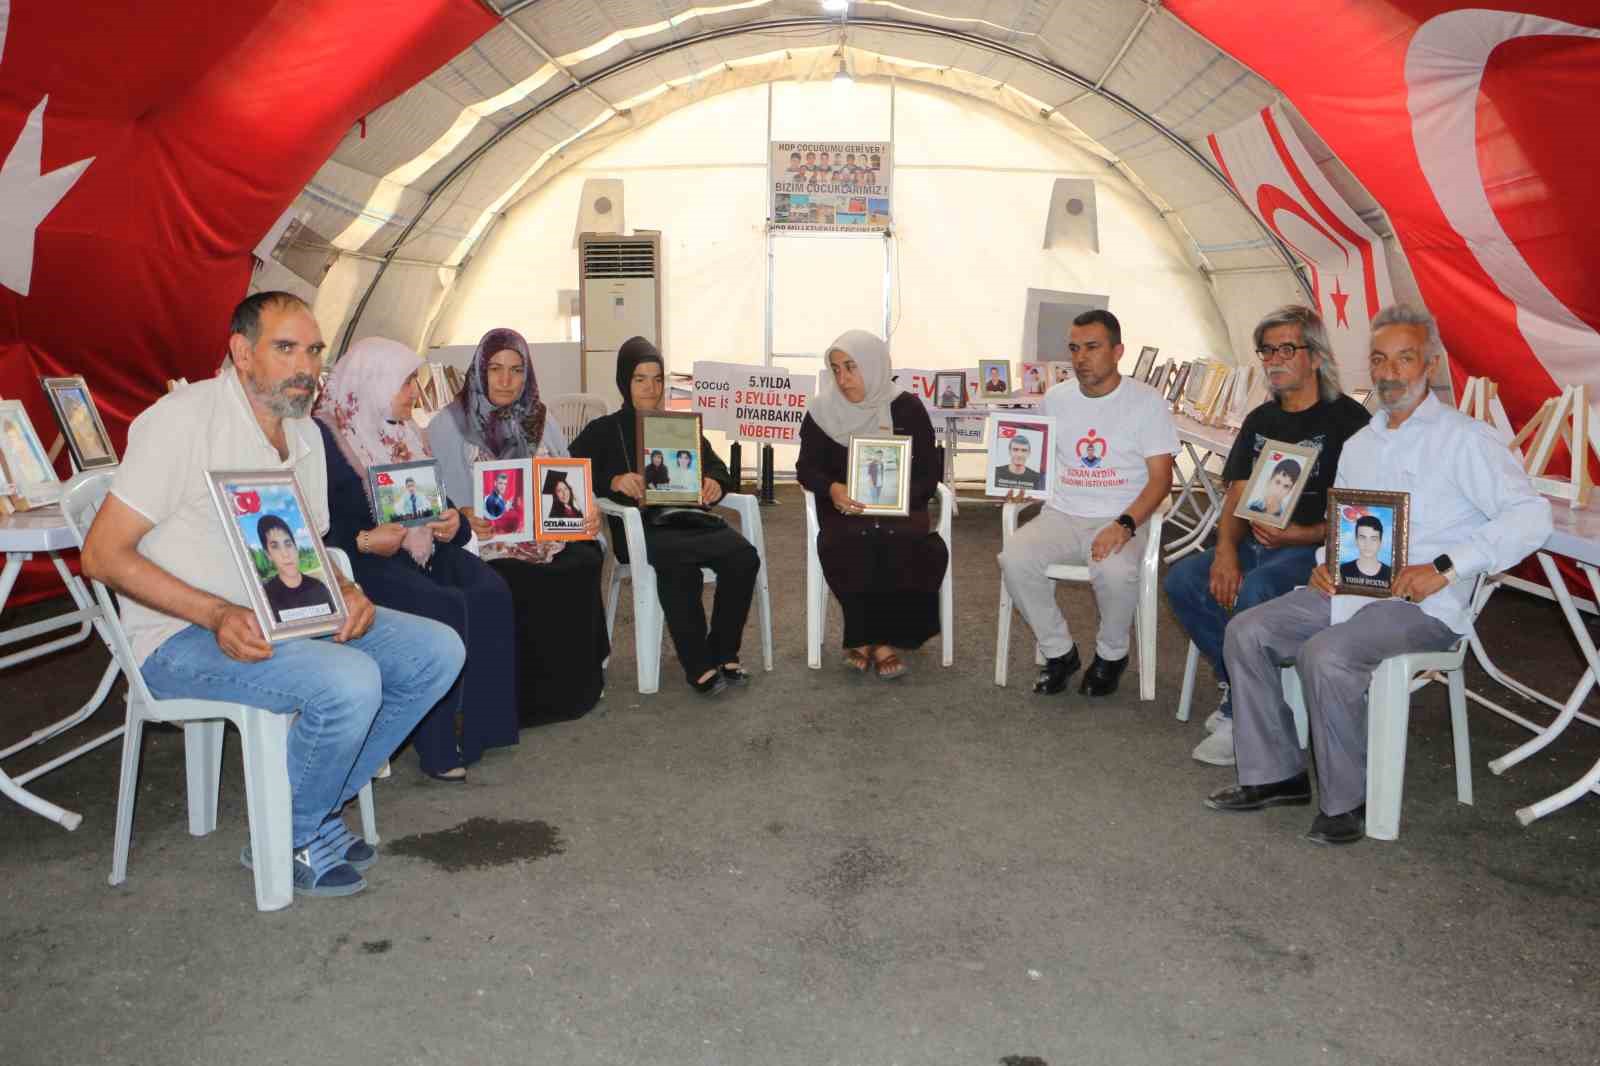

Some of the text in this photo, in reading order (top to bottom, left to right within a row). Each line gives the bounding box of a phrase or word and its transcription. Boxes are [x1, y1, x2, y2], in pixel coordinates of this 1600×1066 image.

[749, 376, 791, 389] 5.YILDA
[698, 395, 717, 408] NE
[735, 390, 743, 404] 3
[736, 405, 803, 423] DİYARBAKIR
